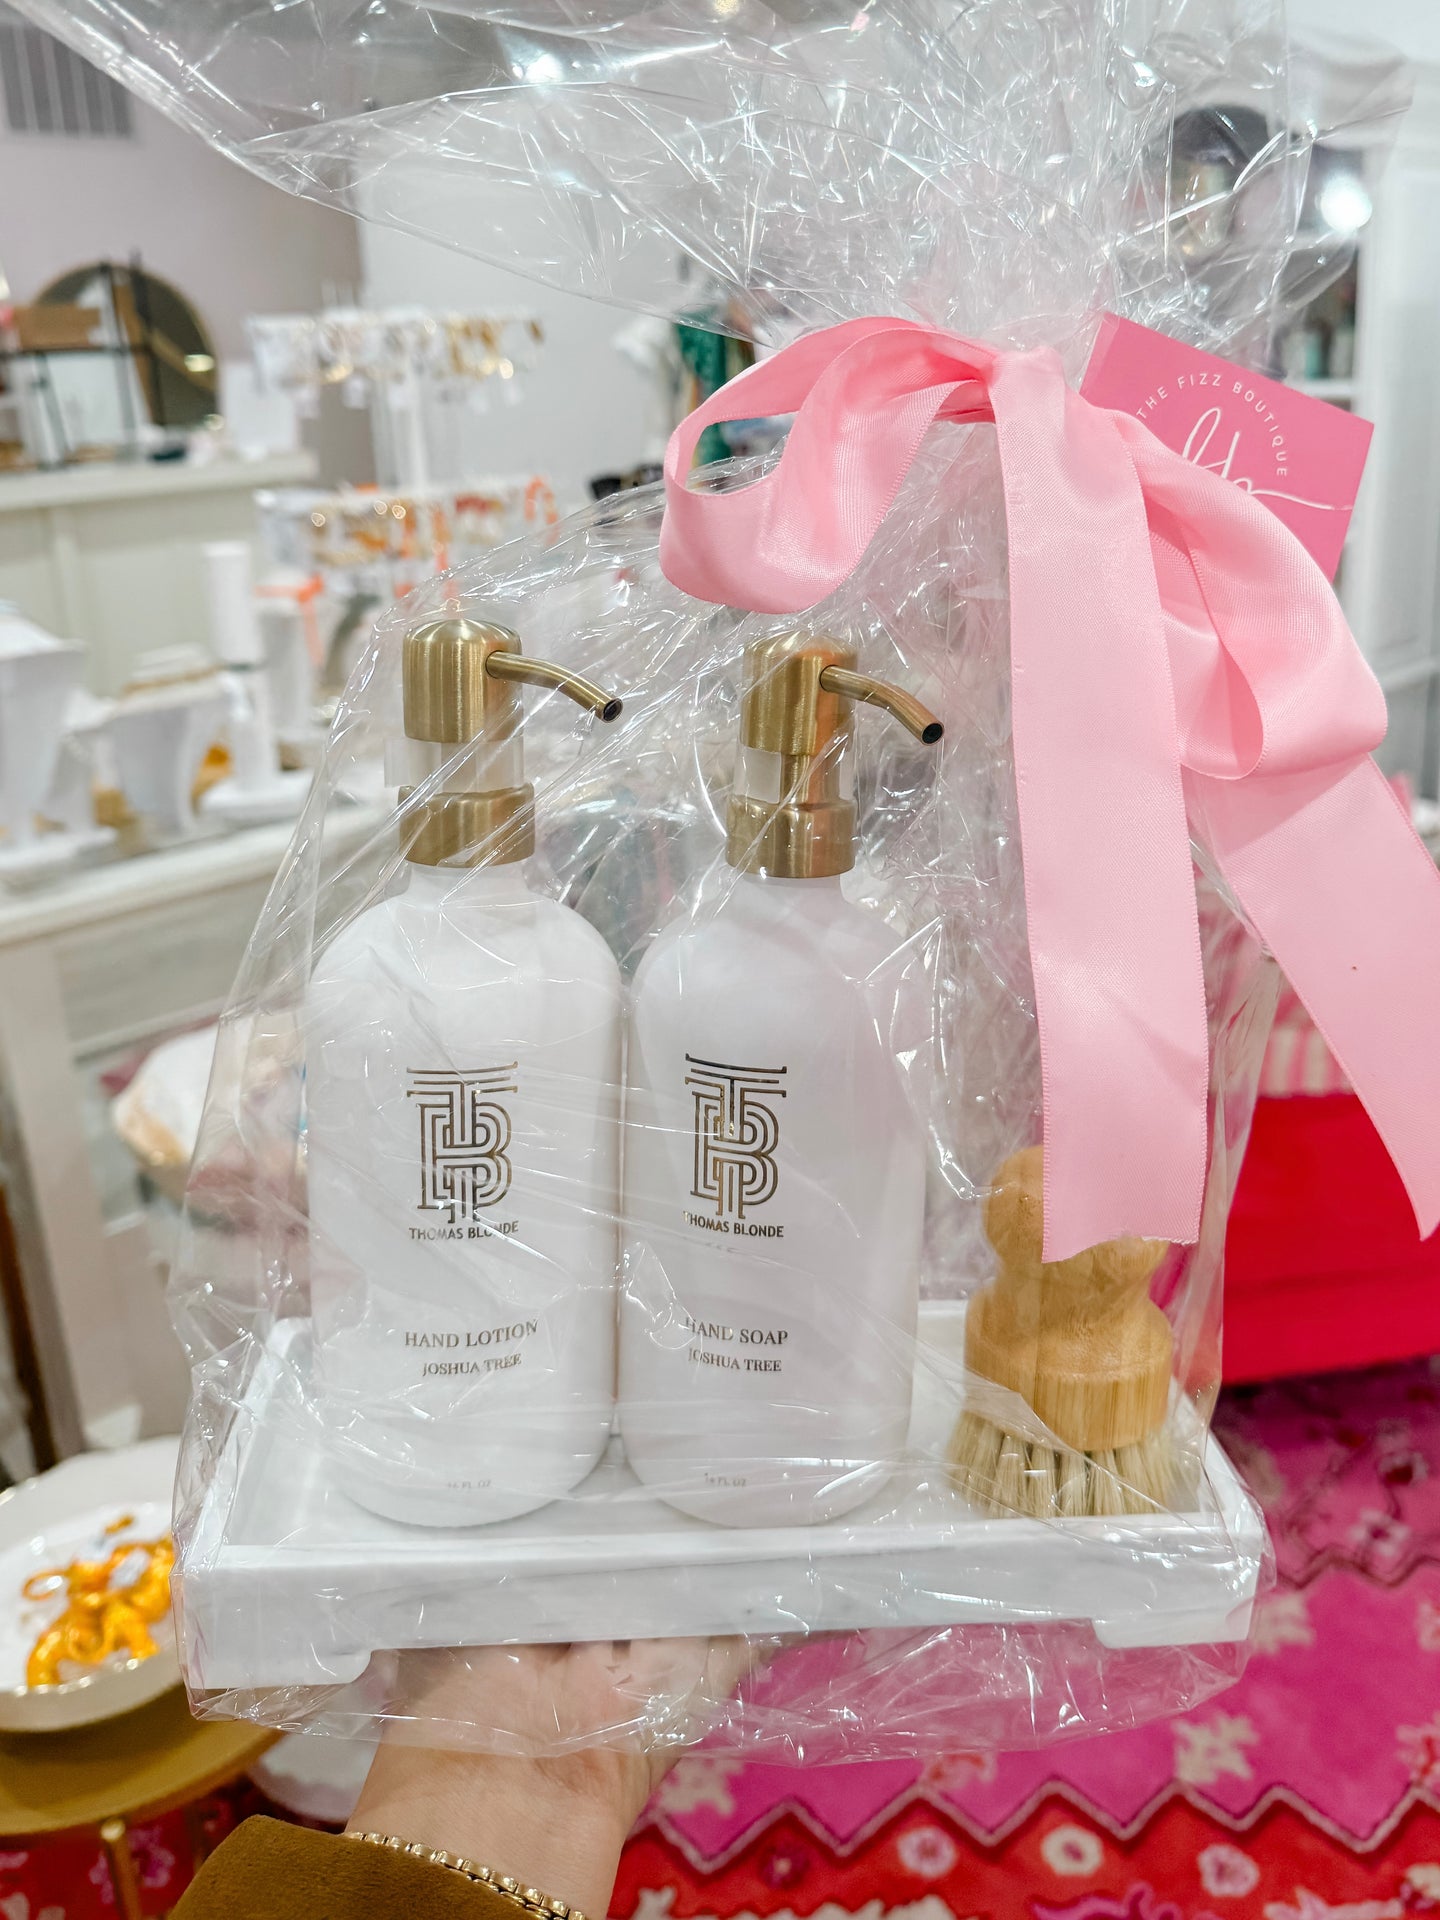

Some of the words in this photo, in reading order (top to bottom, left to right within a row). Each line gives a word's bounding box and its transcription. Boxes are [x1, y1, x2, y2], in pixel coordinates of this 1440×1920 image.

[1136, 386, 1169, 419] THE
[1177, 373, 1222, 389] FIZZ
[1232, 381, 1288, 477] BOUTIQUE
[409, 1227, 463, 1240] THOMAS
[683, 1210, 730, 1233] THOMAS
[733, 1222, 784, 1237] BLONDE
[405, 1331, 460, 1348] HAND
[466, 1319, 538, 1347] LOTION
[685, 1317, 734, 1341] HAND
[739, 1328, 788, 1345] SOAP
[422, 1362, 480, 1377] JOSHUA
[483, 1353, 522, 1372] TREE
[688, 1348, 740, 1370] JOSHUA
[744, 1358, 782, 1372] TREE
